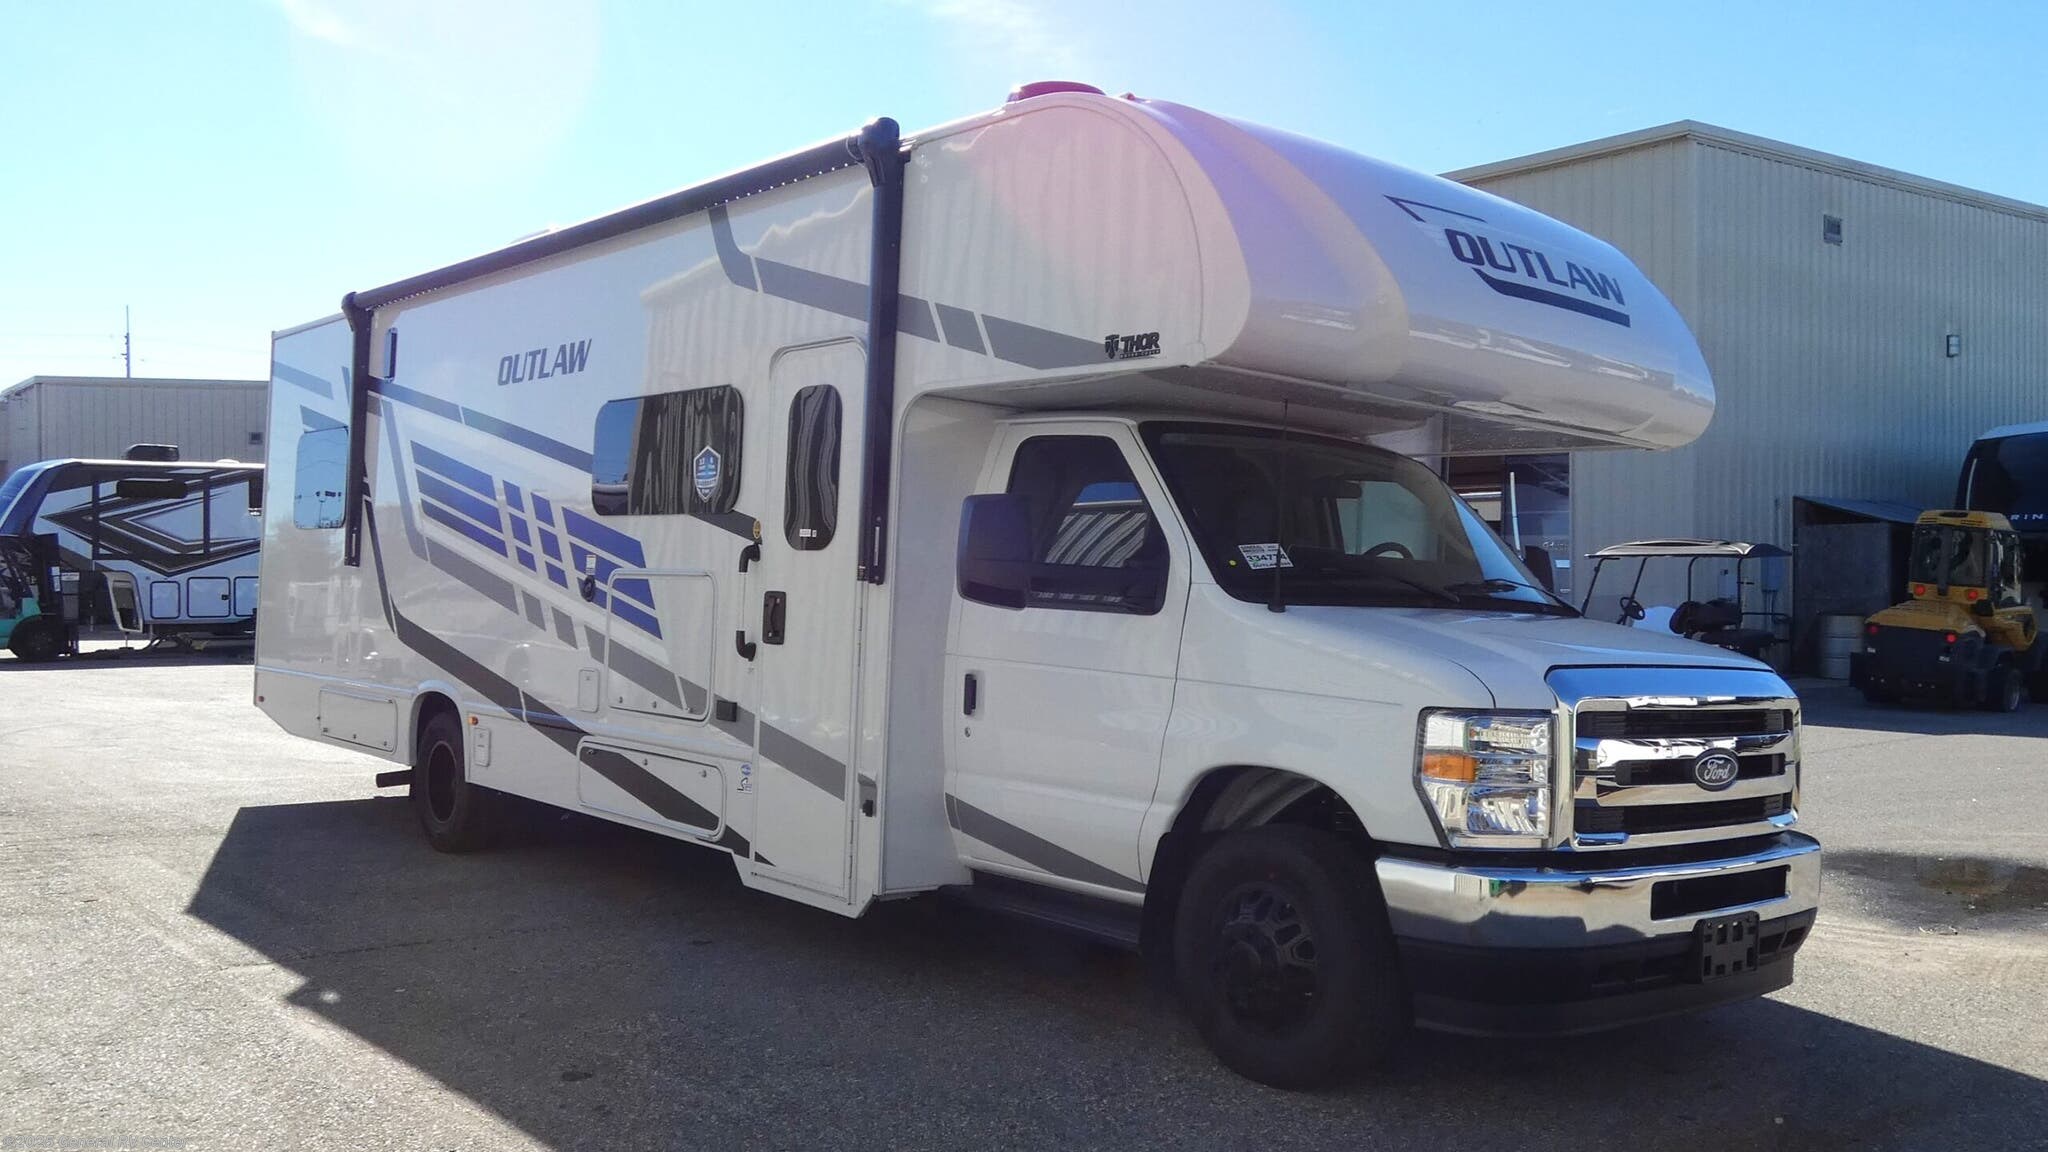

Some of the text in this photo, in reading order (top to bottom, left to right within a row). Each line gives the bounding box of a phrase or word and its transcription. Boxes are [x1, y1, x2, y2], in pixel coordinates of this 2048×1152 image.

[1444, 228, 1625, 306] OUTLAW
[1120, 332, 1160, 353] THOR
[498, 338, 592, 386] OUTLAW
[1704, 759, 1731, 781] Ford
